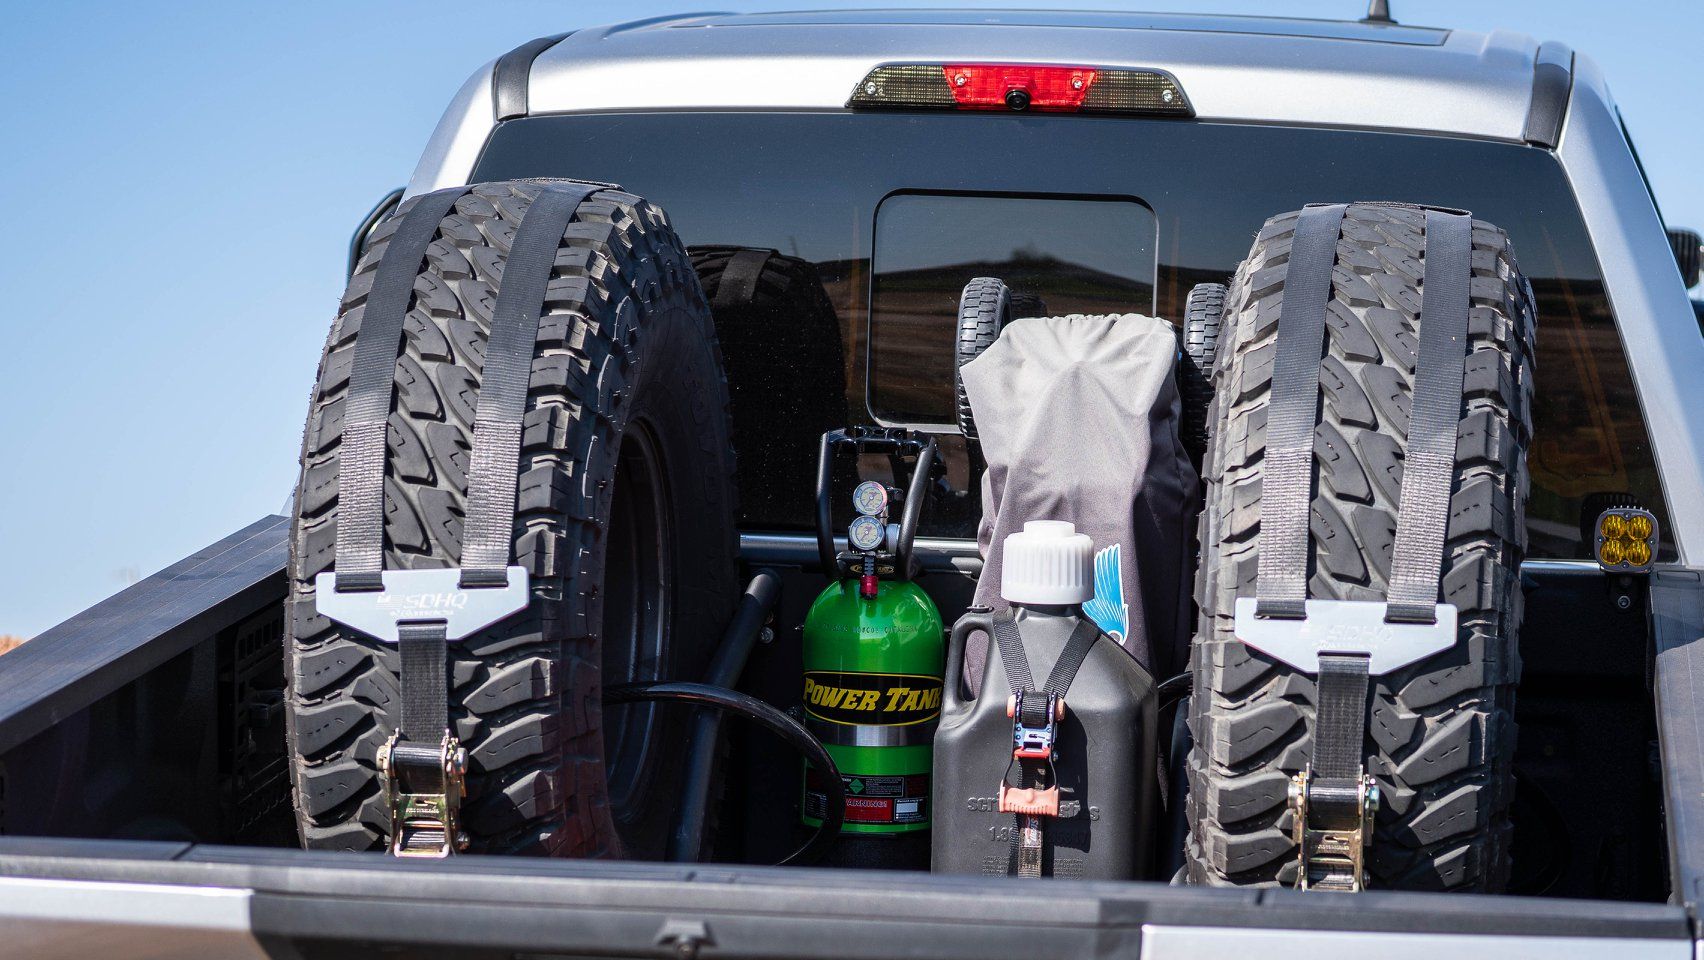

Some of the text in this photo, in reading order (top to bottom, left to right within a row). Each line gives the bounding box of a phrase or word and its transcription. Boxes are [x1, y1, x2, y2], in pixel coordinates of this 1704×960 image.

[403, 592, 468, 609] SDHQ
[803, 678, 881, 711] POWER
[845, 799, 888, 808] ARNING!
